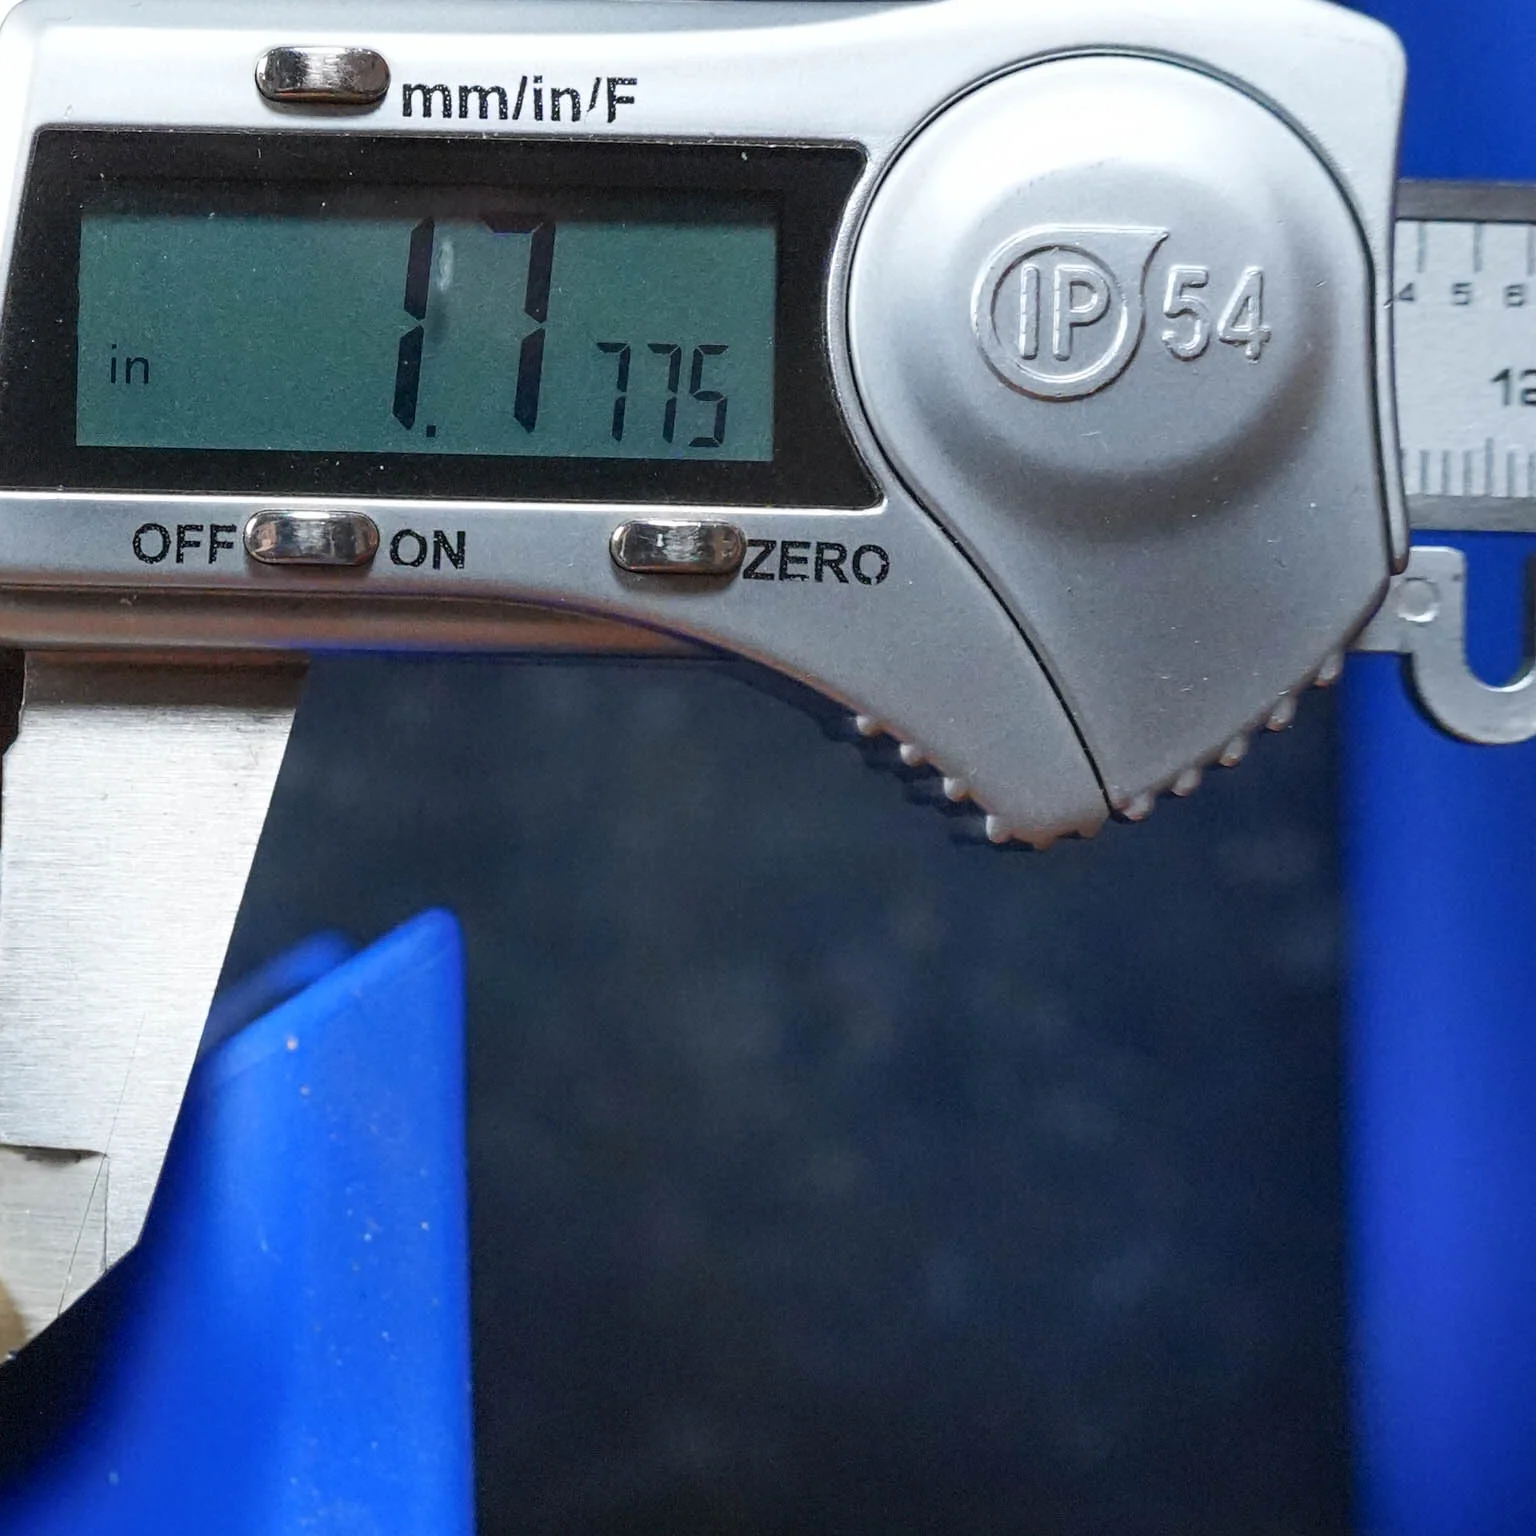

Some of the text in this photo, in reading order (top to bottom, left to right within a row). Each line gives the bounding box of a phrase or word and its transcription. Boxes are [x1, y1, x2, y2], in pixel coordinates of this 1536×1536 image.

[401, 74, 638, 124] mm/in/F
[1017, 263, 1272, 364] IP 54
[1451, 281, 1473, 307] 5
[109, 342, 151, 386] in
[131, 522, 238, 566] OFF
[389, 528, 467, 571] ON
[742, 538, 892, 586] ZERO
